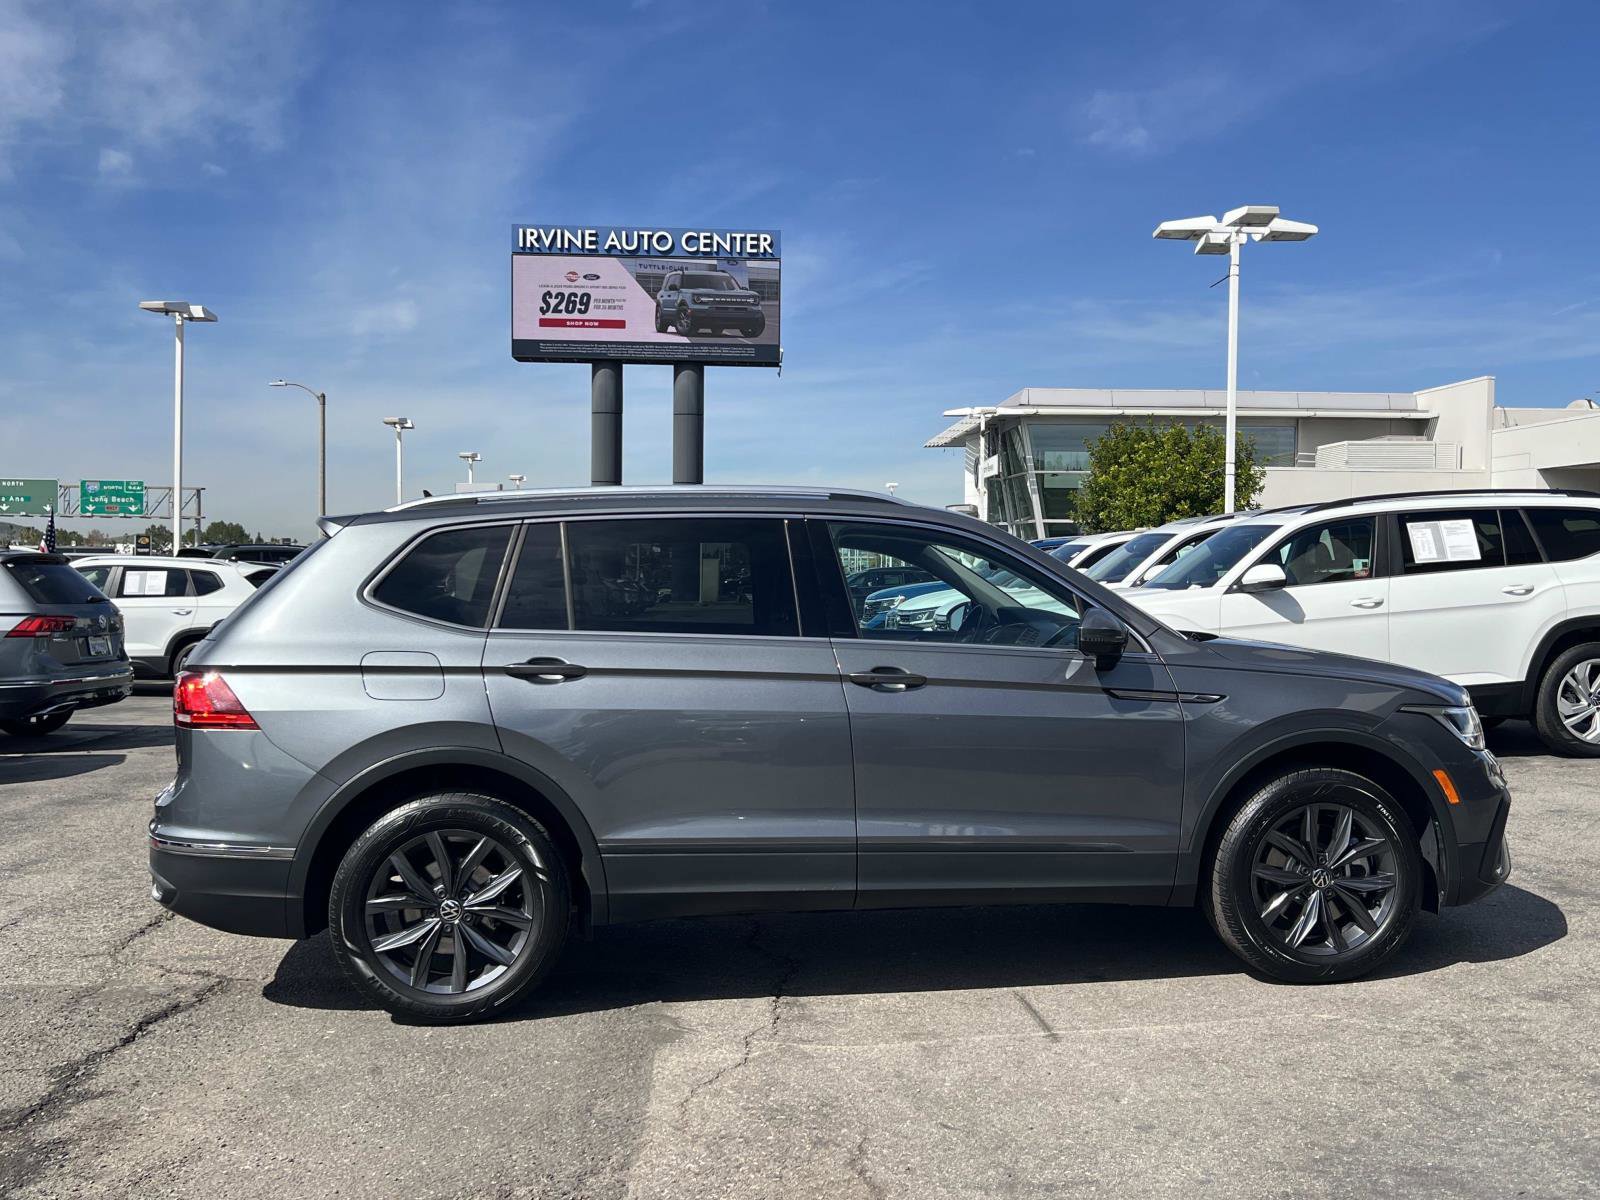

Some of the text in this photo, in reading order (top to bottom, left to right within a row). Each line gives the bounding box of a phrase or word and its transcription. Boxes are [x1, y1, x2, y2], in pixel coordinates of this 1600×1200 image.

[518, 228, 774, 254] IRVINE AUTO CENTER
[539, 290, 592, 316] $269
[89, 495, 135, 503] Long Beach
